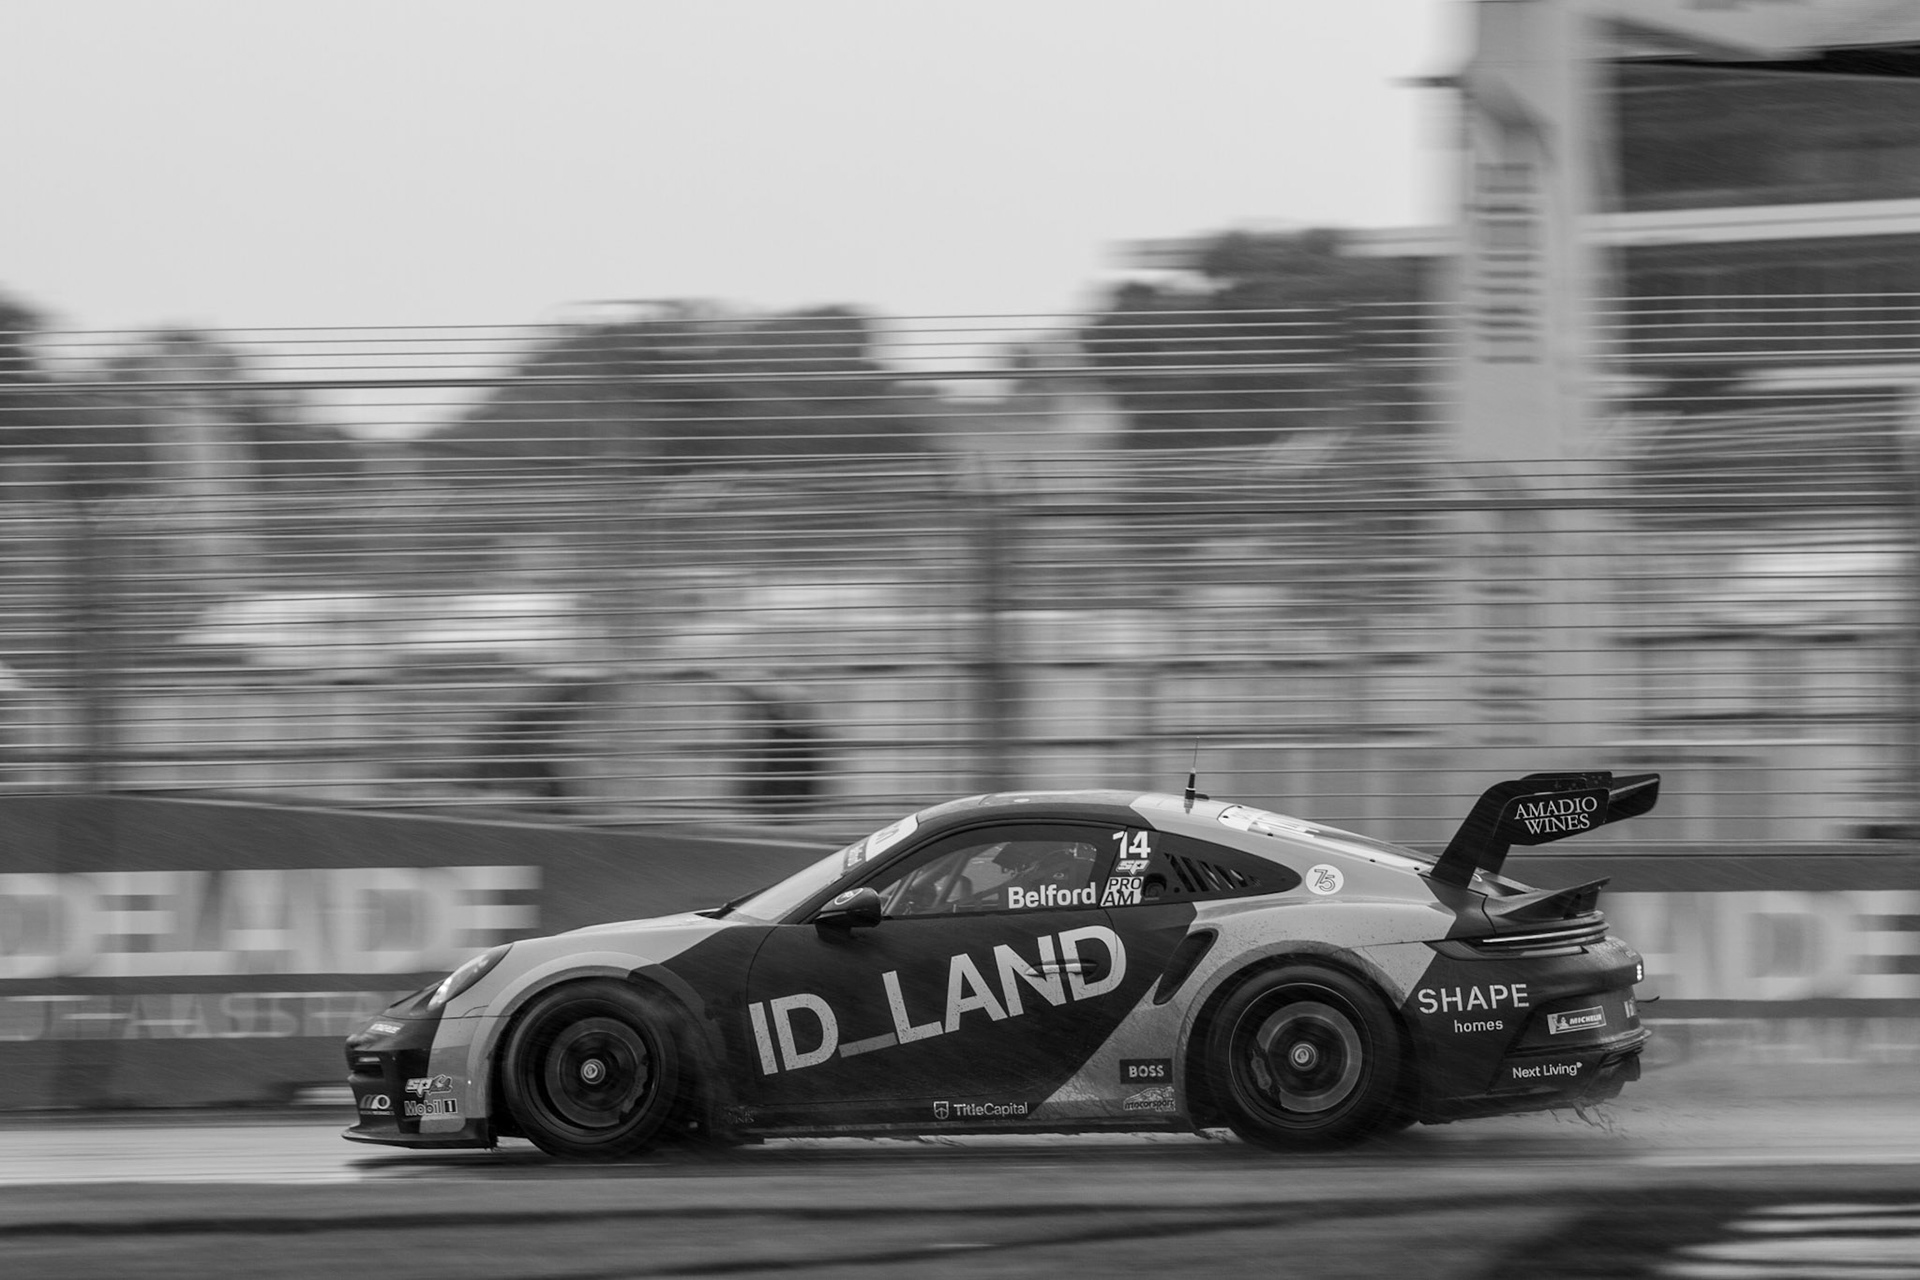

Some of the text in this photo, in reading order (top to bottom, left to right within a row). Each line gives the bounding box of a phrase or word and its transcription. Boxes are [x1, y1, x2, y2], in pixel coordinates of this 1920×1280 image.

[1514, 796, 1598, 820] AMADIO
[1524, 813, 1590, 835] WINES
[1112, 831, 1151, 859] 14
[1108, 877, 1142, 890] PRO
[1314, 869, 1336, 892] 75
[1008, 882, 1097, 909] Belford
[1102, 890, 1134, 906] AM
[748, 925, 1127, 1076] ID_LAND
[1417, 983, 1530, 1014] SHAPE
[1454, 1020, 1504, 1033] homes
[1128, 1065, 1165, 1078] BOSS
[1512, 1063, 1577, 1079] Next Living
[404, 1099, 441, 1116] Mobil
[953, 1102, 1028, 1117] TitleCapital
